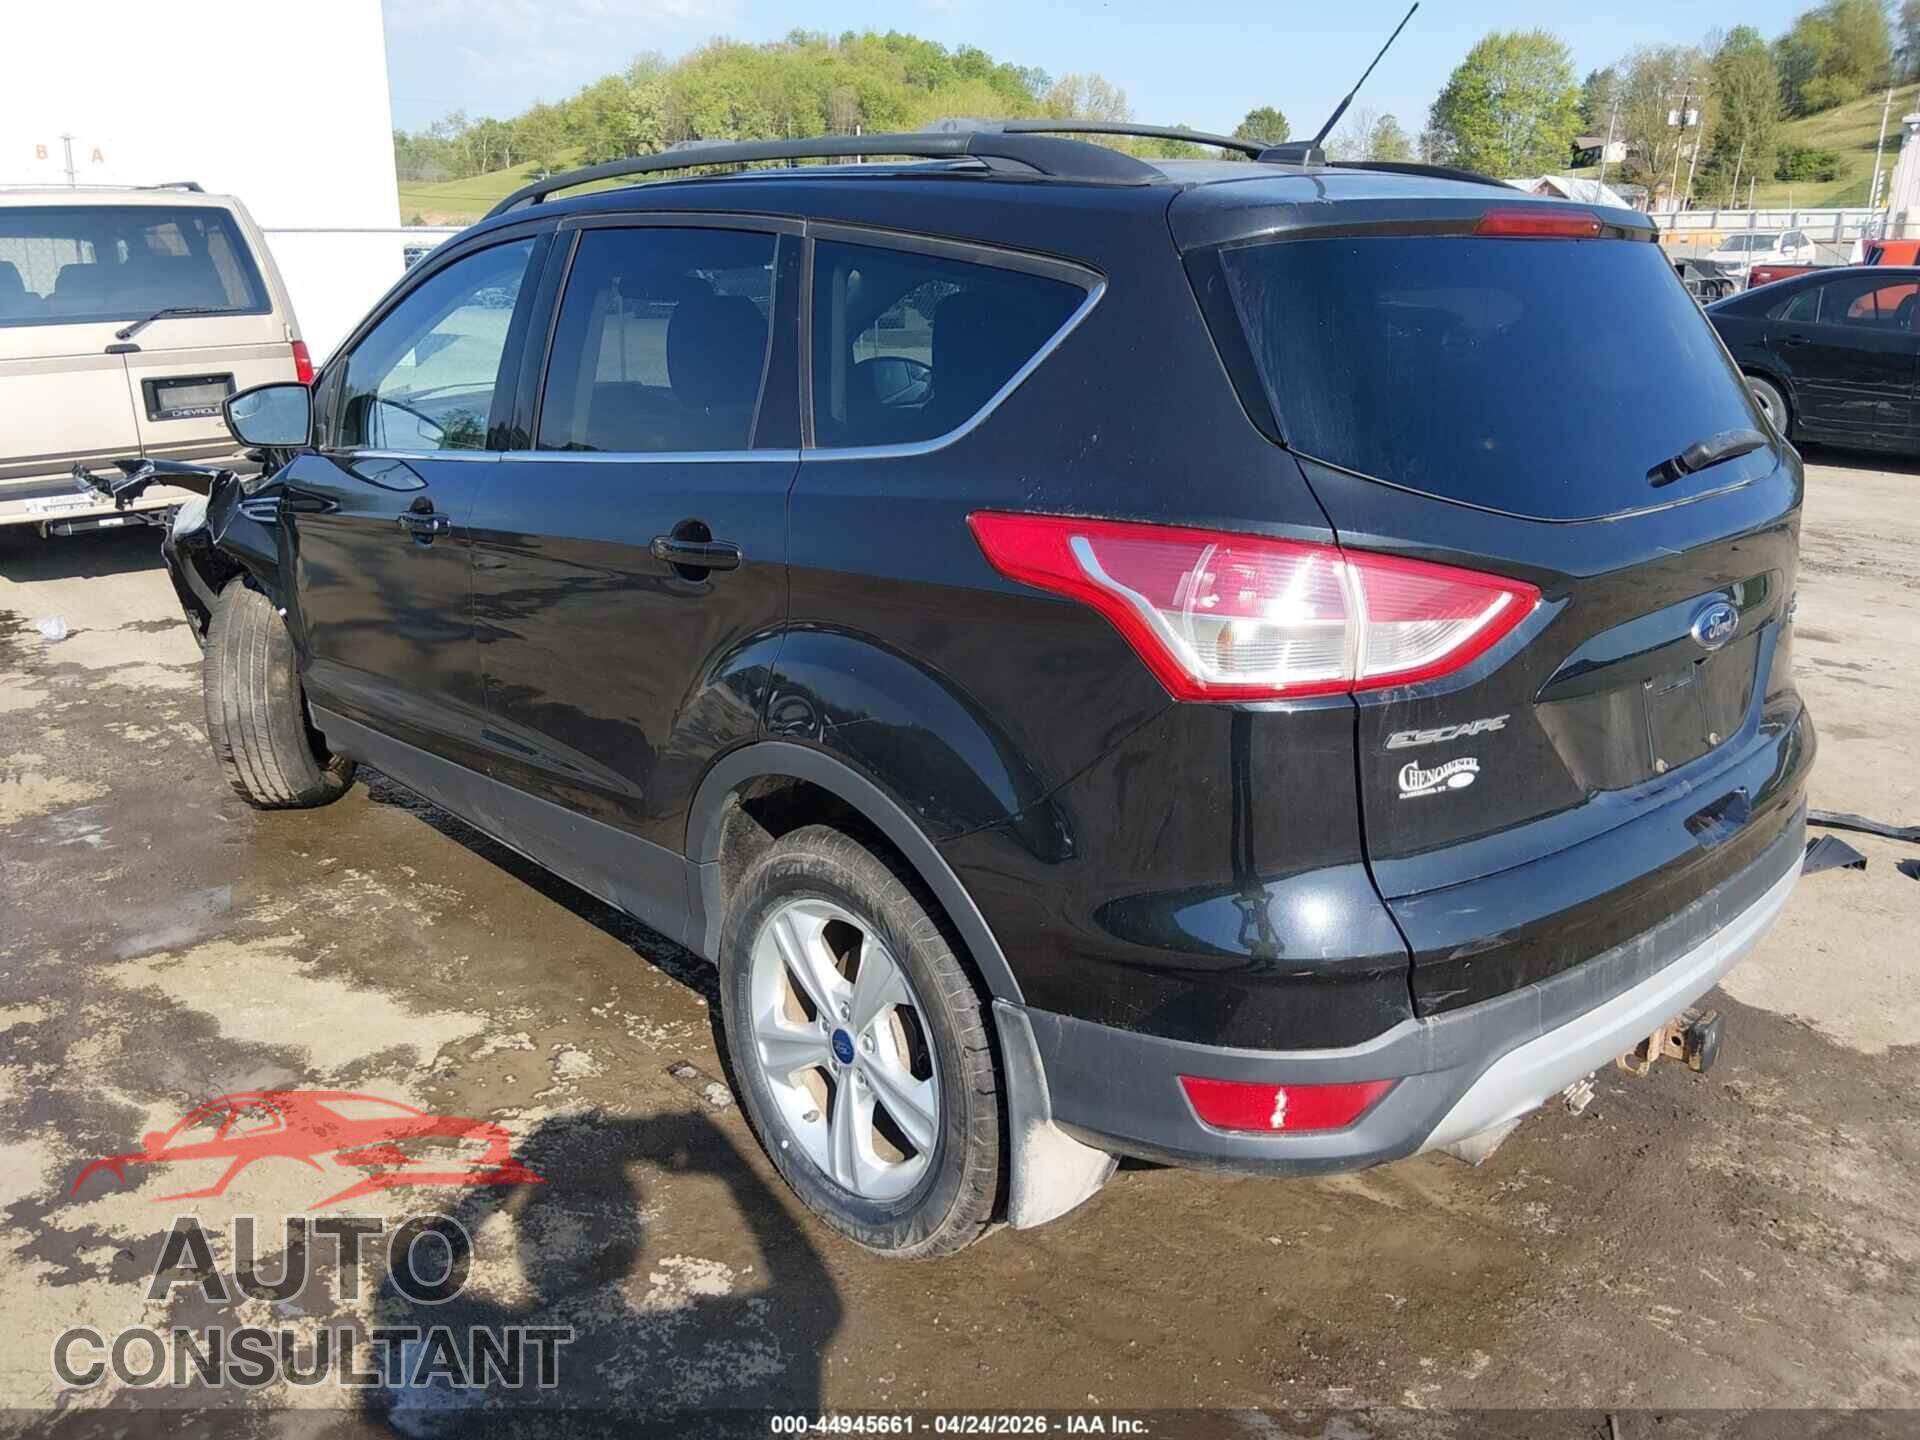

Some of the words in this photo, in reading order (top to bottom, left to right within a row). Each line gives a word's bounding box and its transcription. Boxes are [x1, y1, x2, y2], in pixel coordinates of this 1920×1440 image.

[36, 144, 48, 160] B
[91, 148, 104, 163] A
[1386, 714, 1511, 749] ESCAPE
